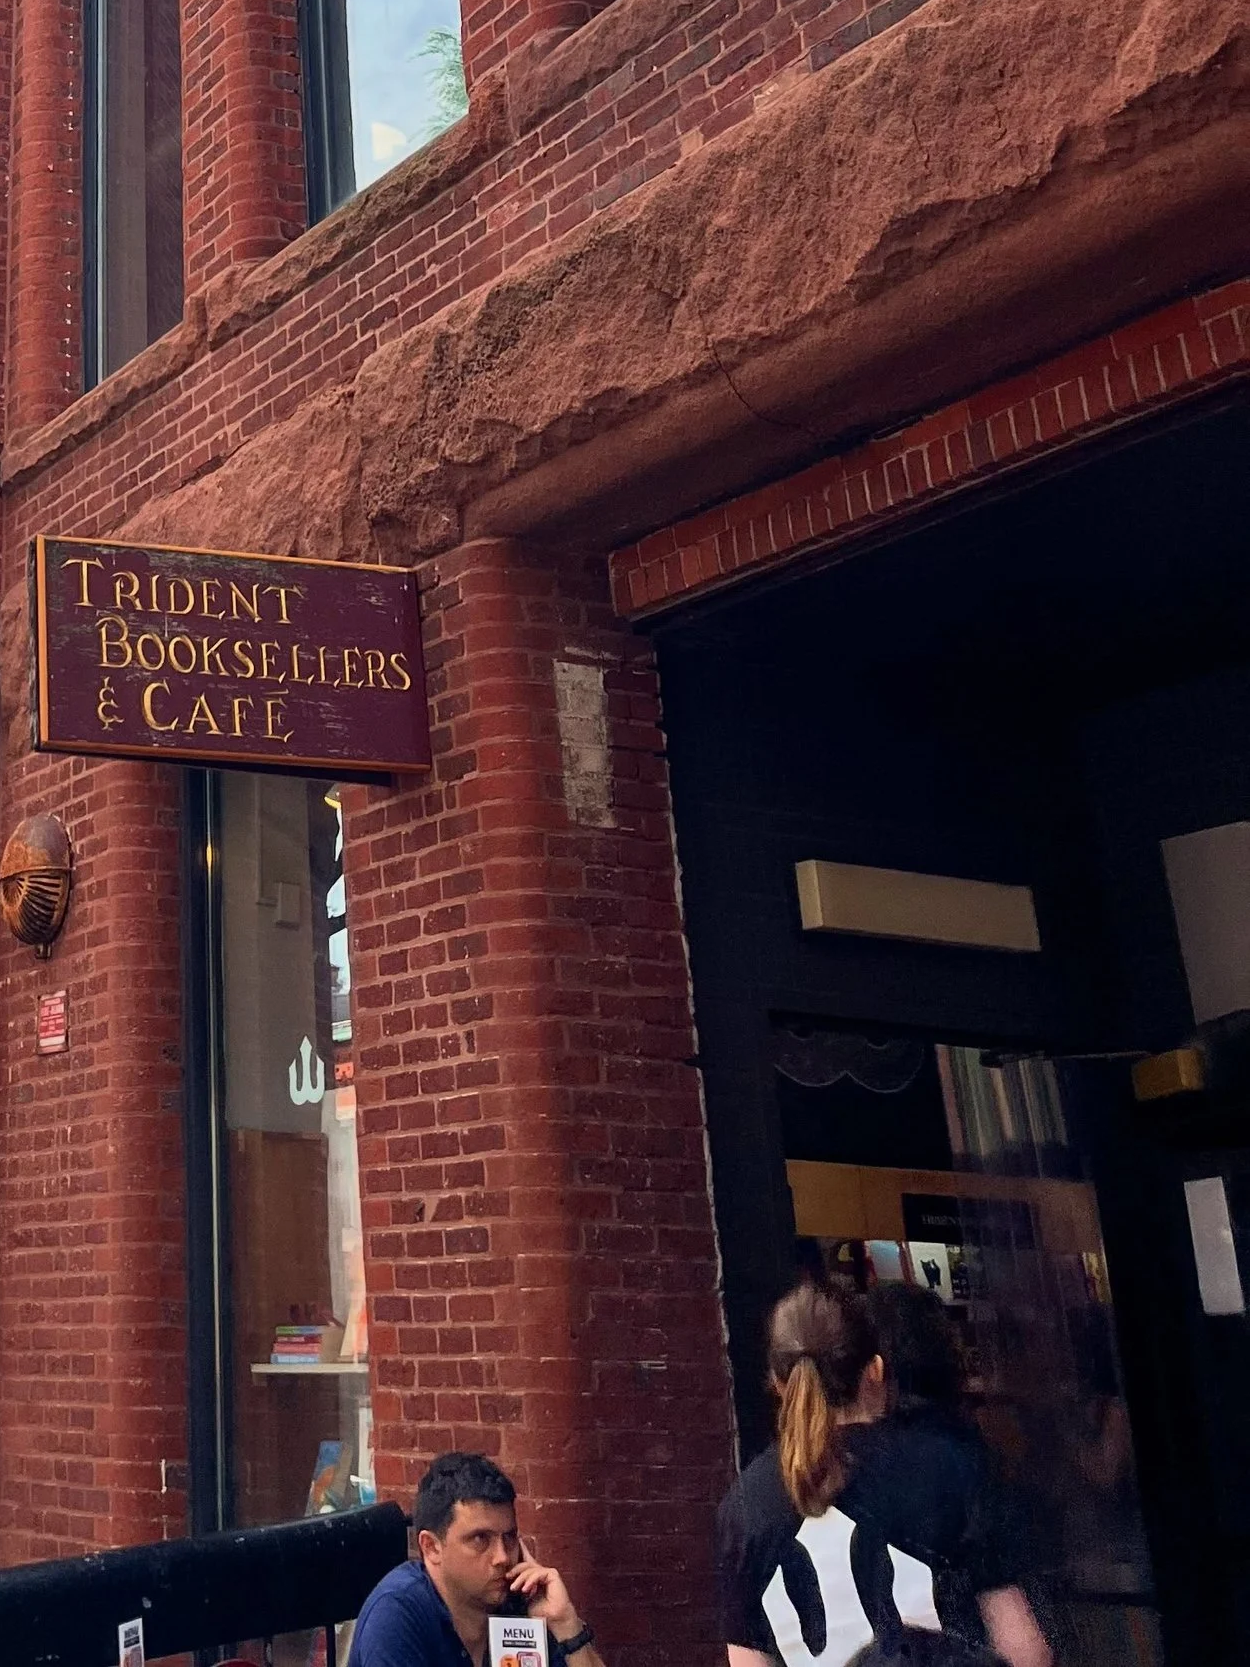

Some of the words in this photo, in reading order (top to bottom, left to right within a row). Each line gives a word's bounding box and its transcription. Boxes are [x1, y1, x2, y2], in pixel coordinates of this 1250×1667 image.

[60, 557, 301, 625] TRIDENT
[95, 613, 411, 691] BOOKSELLERS
[97, 676, 125, 731] &
[503, 1628, 535, 1639] MENU
